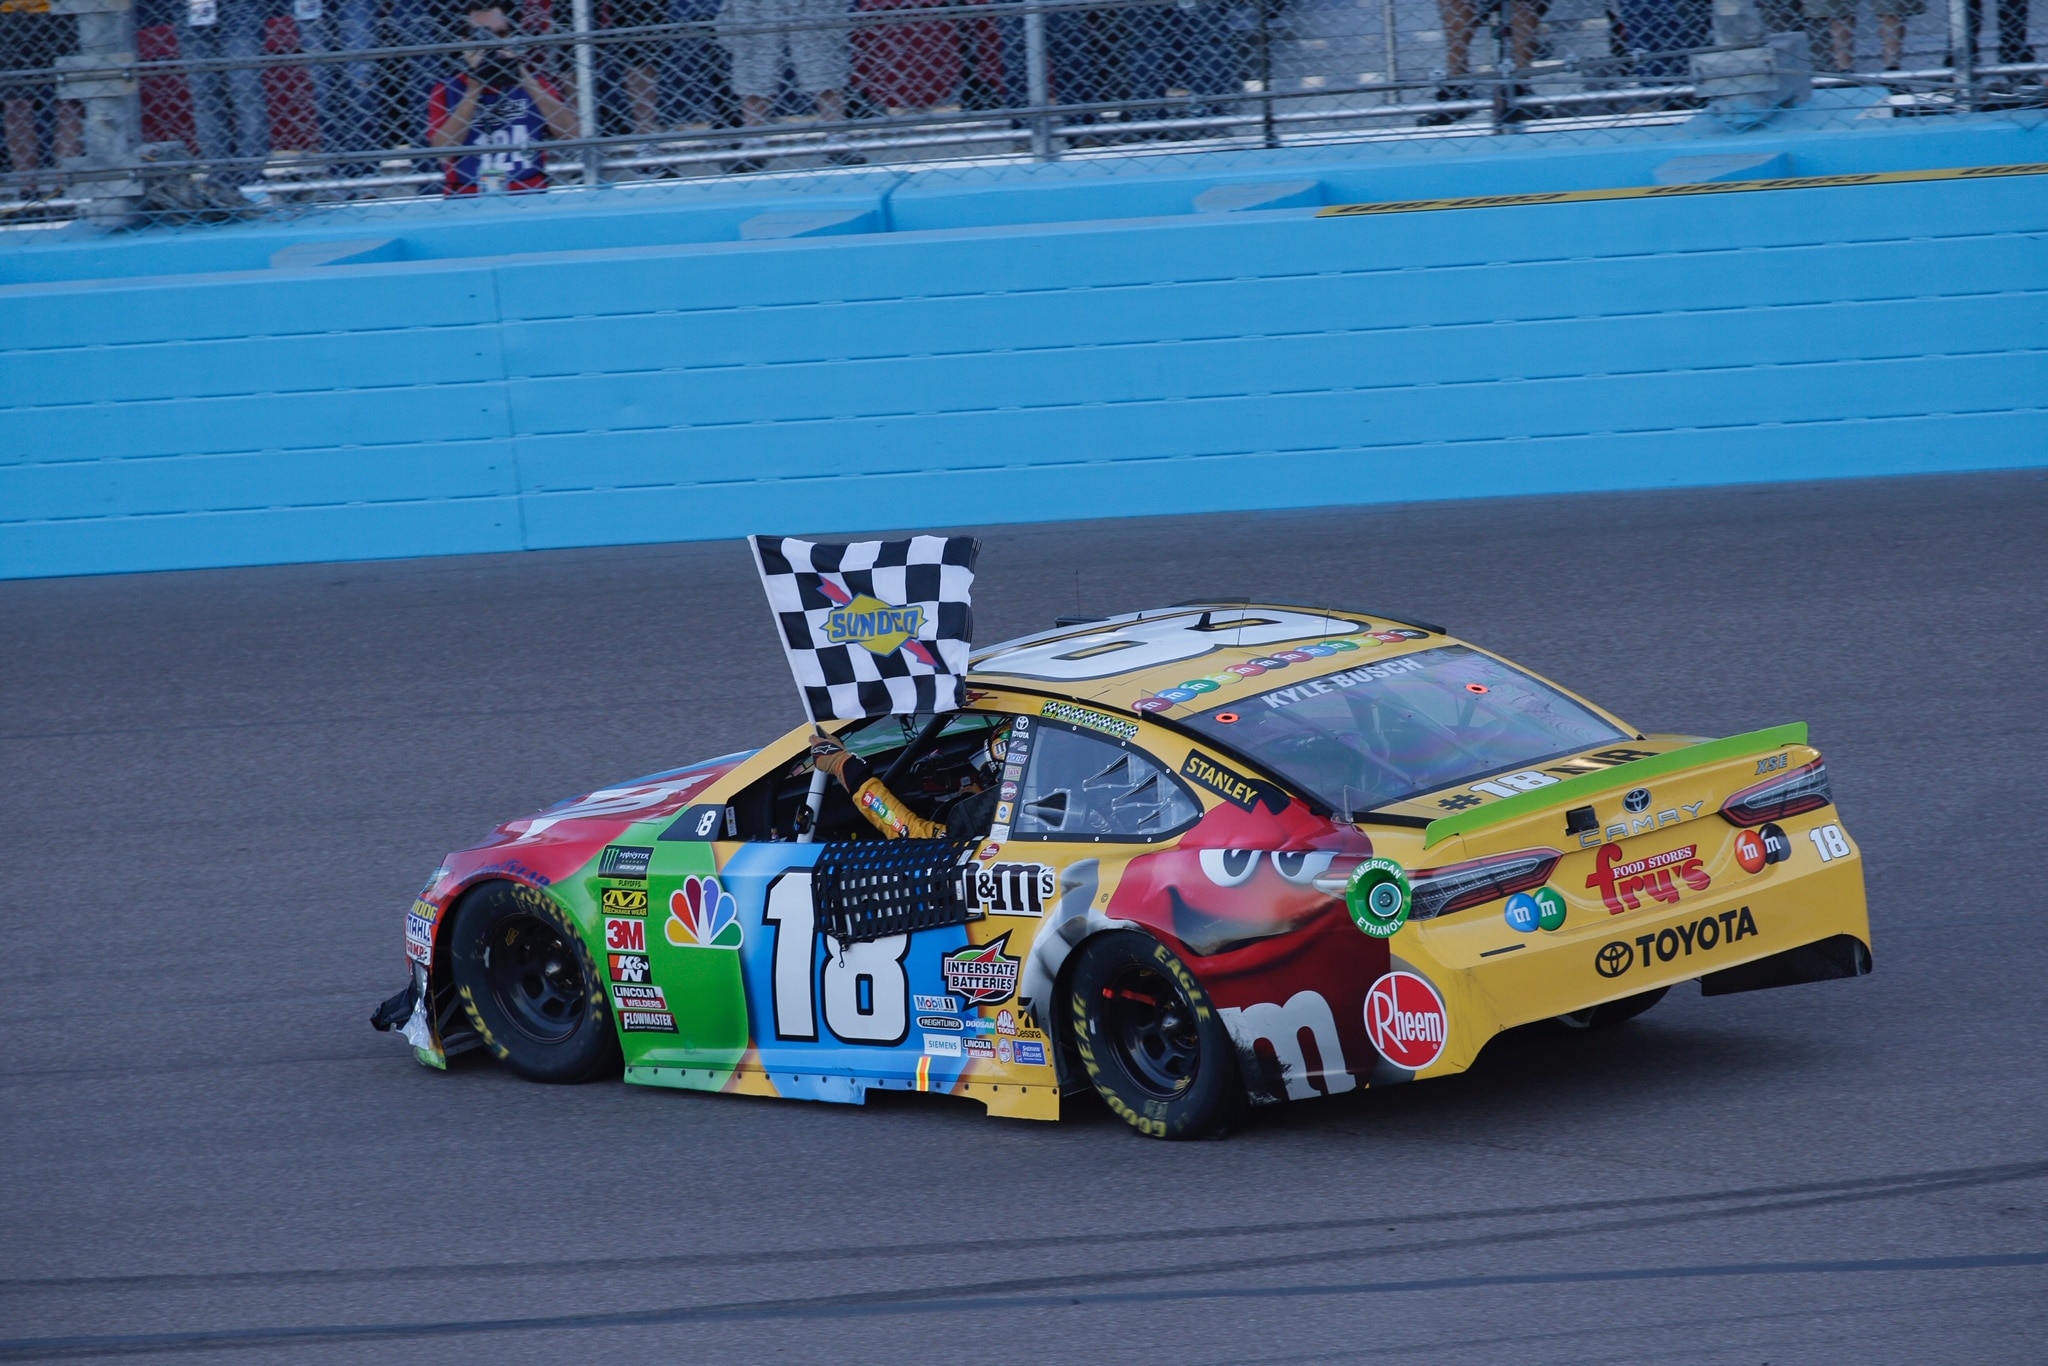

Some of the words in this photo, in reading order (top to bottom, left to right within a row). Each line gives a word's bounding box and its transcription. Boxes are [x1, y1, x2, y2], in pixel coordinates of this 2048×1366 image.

[831, 609, 920, 638] SUNOCO
[1261, 679, 1334, 709] KYLE
[1330, 657, 1425, 689] BUSCH
[1755, 752, 1788, 776] XSE
[1186, 756, 1259, 804] STANLEY
[1579, 800, 1705, 848] CAMRY
[1809, 823, 1851, 862] 18
[1352, 860, 1402, 884] AMERICAN
[1612, 863, 1646, 879] FOOD
[1648, 846, 1693, 868] STORES
[1585, 842, 1712, 915] fry's
[607, 920, 645, 950] 3M
[1356, 917, 1404, 936] ETHANOL
[1635, 906, 1759, 968] TOYOTA
[947, 961, 1016, 976] INTERSTATE
[614, 986, 654, 999] LINCOLN
[952, 976, 1012, 990] BATTERIES
[1154, 943, 1211, 1023] EAGLE
[625, 999, 662, 1008] WELDERS
[916, 996, 944, 1009] Mobil
[623, 1012, 673, 1030] FLOWMASTER
[921, 1018, 960, 1028] FREIGHTLINER
[965, 1019, 996, 1029] DOOSAN
[1372, 975, 1442, 1054] Rheem
[998, 1027, 1016, 1036] TOOLS
[1016, 1027, 1042, 1039] Cessna
[928, 1039, 957, 1050] SIEMENS
[964, 1039, 991, 1049] LINCOLN
[969, 1049, 994, 1057] WELDERS
